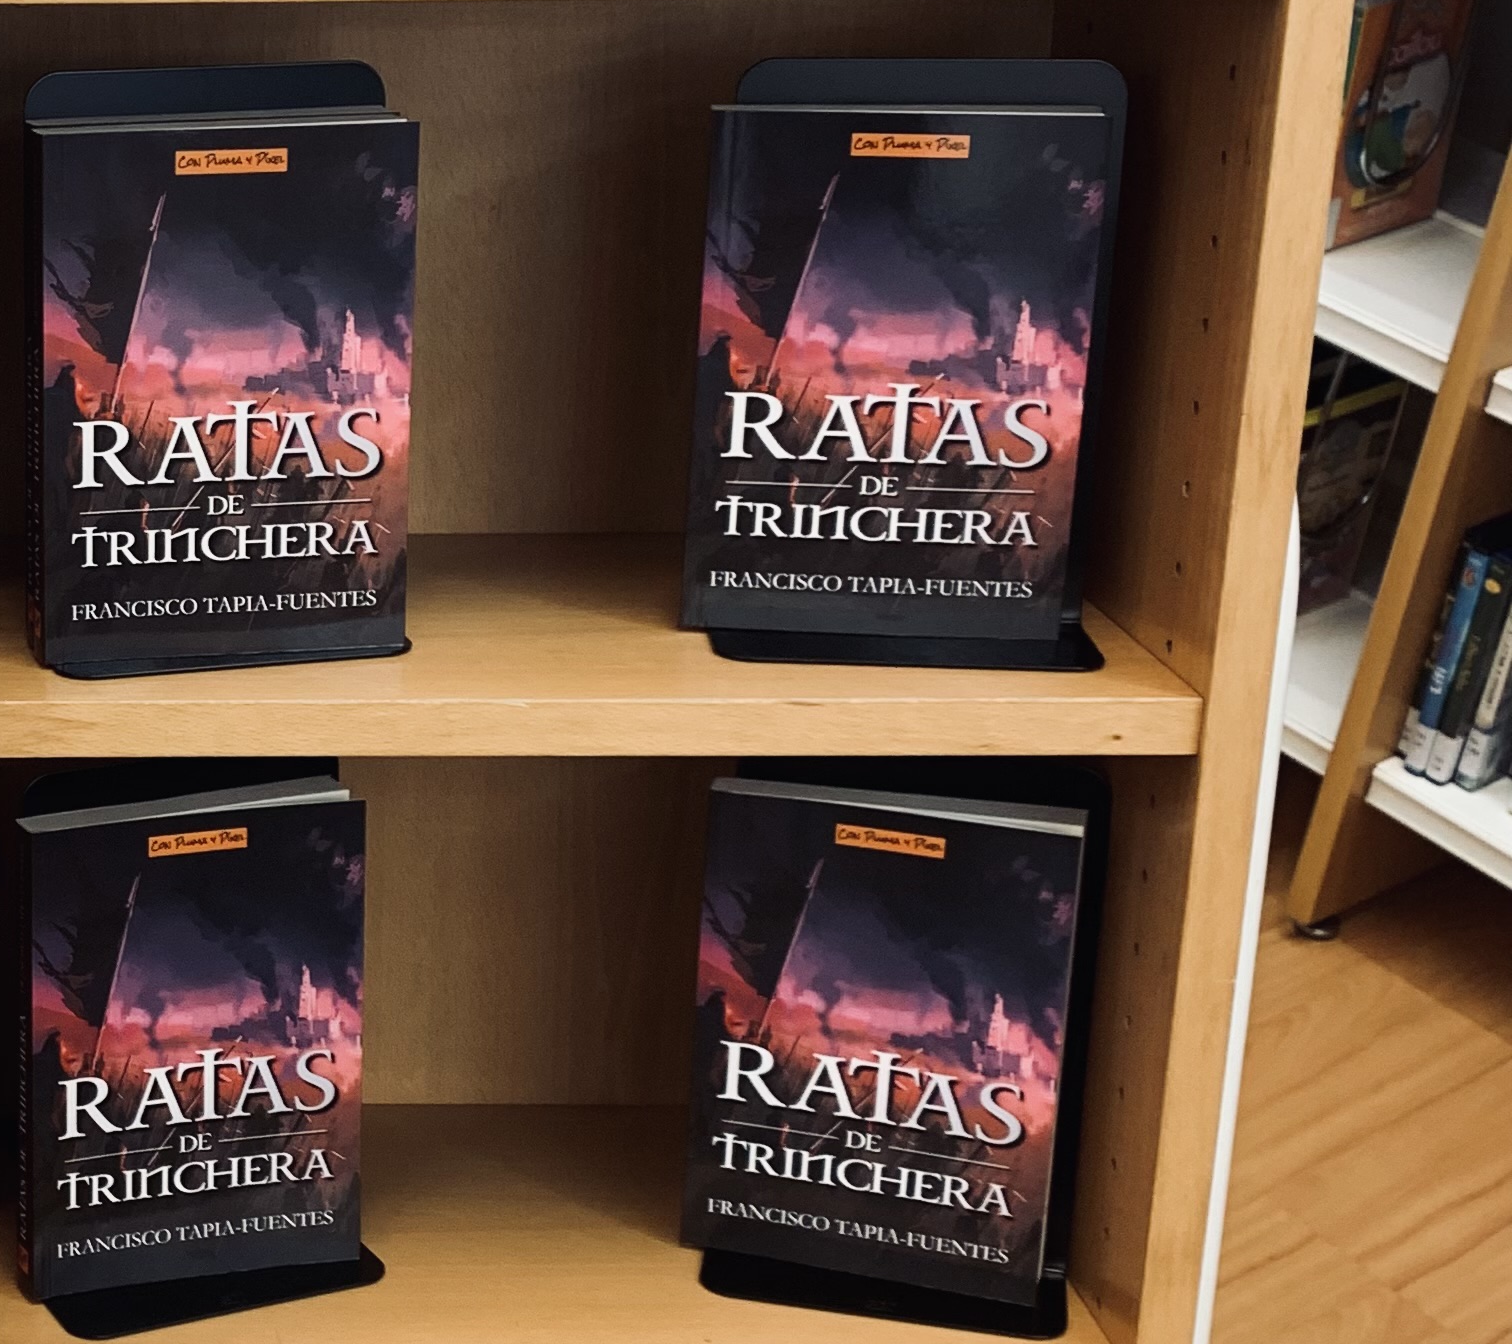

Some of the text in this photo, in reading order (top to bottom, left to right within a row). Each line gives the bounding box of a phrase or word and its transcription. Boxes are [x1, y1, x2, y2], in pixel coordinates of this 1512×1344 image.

[72, 400, 382, 490] RATAS
[720, 383, 1052, 469] RATAS
[207, 495, 245, 516] DE
[859, 475, 899, 497] DE
[71, 519, 379, 568] TRINCHERA
[715, 494, 1038, 546] TRINCHERA
[71, 589, 377, 621] FRANCISCO TAPIA-FUENTES
[709, 570, 1033, 599] FRANCISCO TAPIA-FUENTES
[57, 1047, 337, 1141] RATAS
[716, 1039, 1025, 1147] RATAS
[178, 1134, 212, 1154] DE
[845, 1131, 882, 1153] DE
[57, 1149, 334, 1211] TRINCHERA
[711, 1132, 1014, 1219] TRINCHERA
[57, 1210, 335, 1260] FRANCISCO TAPIA-FUENTES
[707, 1197, 1010, 1265] FRANCISCO TAPIA-FUENTES
